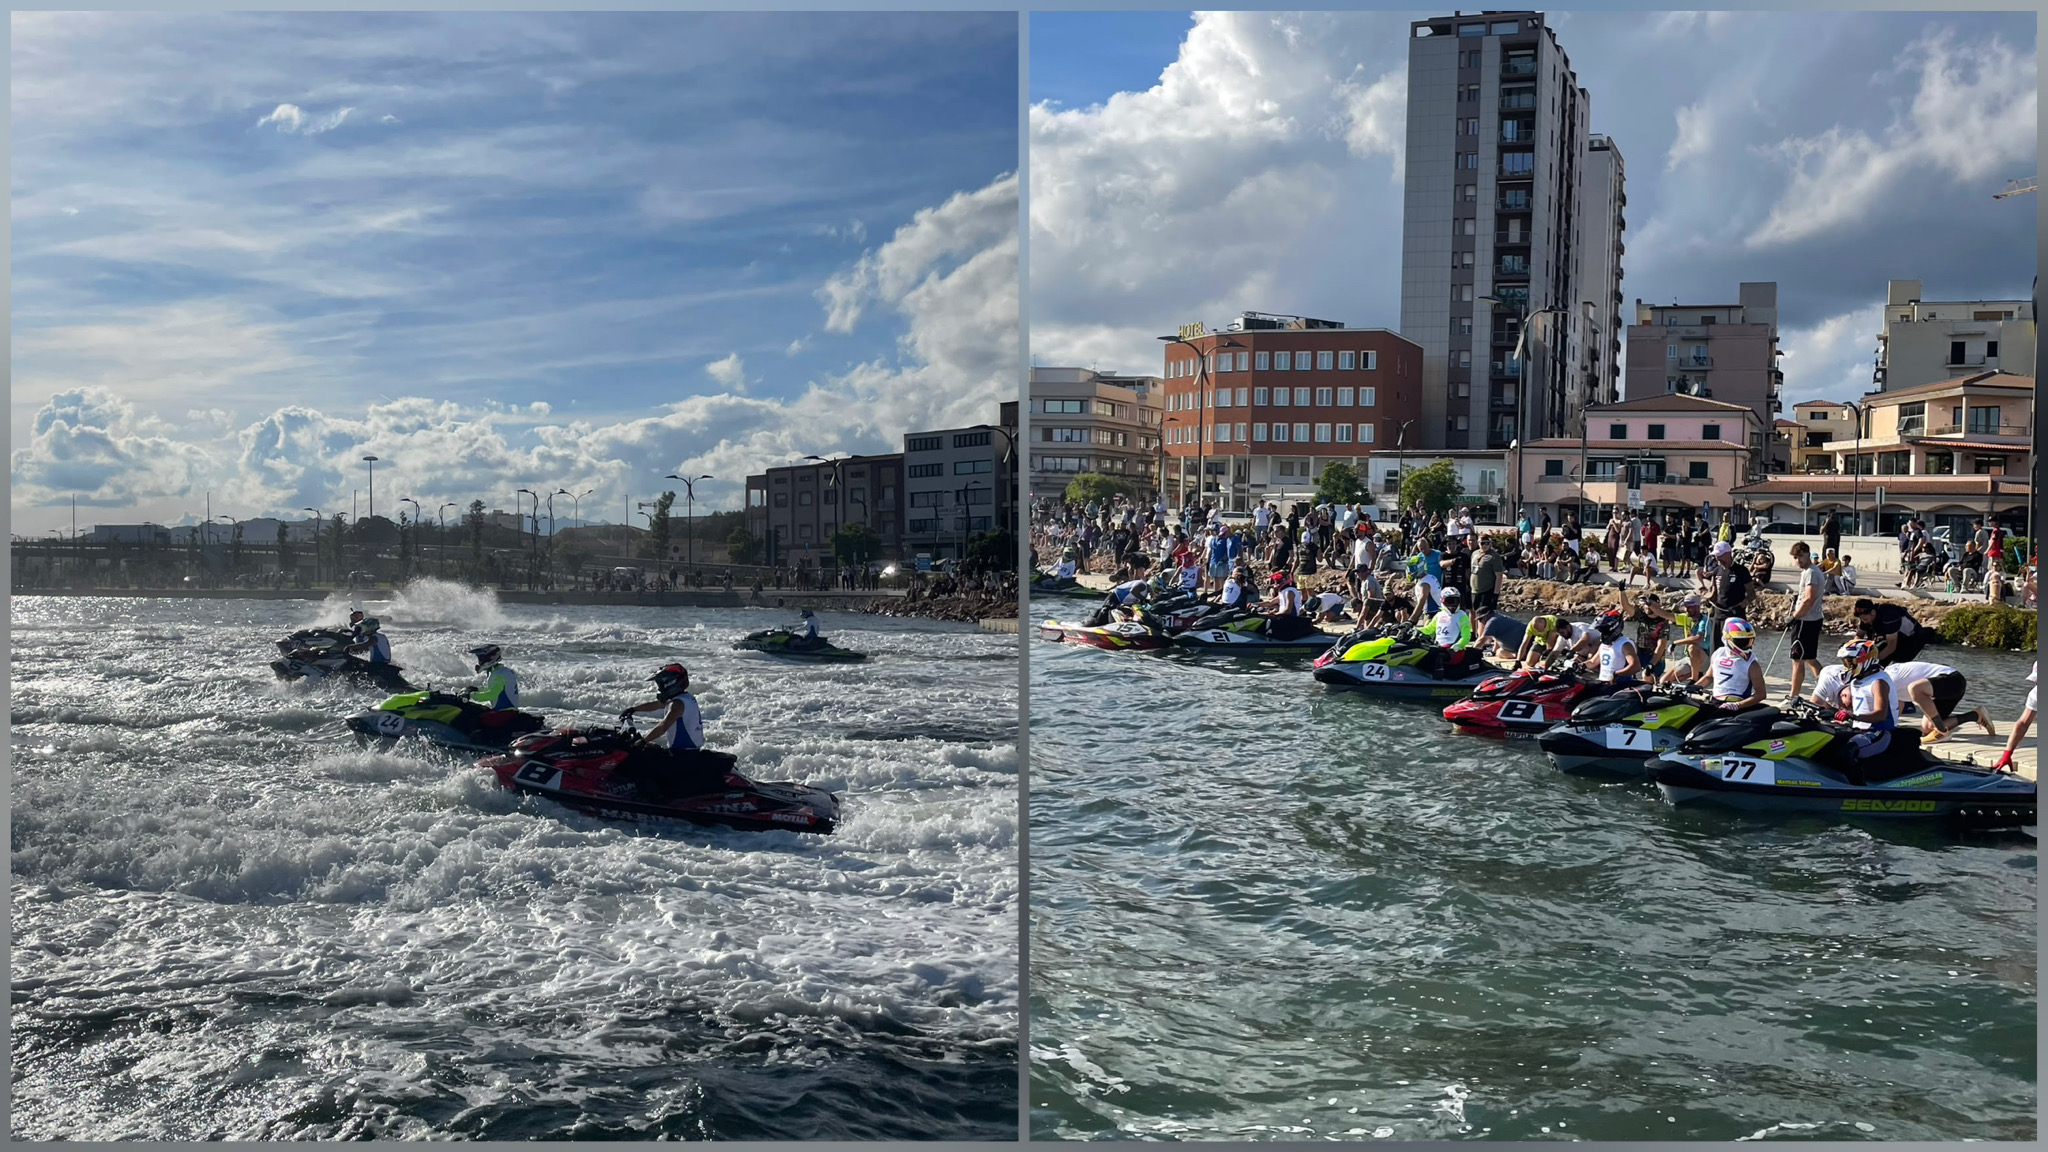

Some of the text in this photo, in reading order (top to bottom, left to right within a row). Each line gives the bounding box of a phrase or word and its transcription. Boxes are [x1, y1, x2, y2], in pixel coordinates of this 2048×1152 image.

[1179, 322, 1205, 338] HOTEL
[1181, 571, 1196, 580] 94
[1117, 624, 1137, 632] 15
[1438, 626, 1450, 636] 24
[1212, 631, 1230, 643] 21
[1602, 653, 1611, 666] 8
[1365, 664, 1385, 679] 24
[1718, 671, 1734, 685] 7
[1500, 702, 1539, 720] 8
[380, 714, 400, 730] 24
[1623, 729, 1637, 746] 7
[516, 762, 554, 785] 8
[1723, 759, 1756, 780] 77
[771, 813, 810, 825] MOTUL
